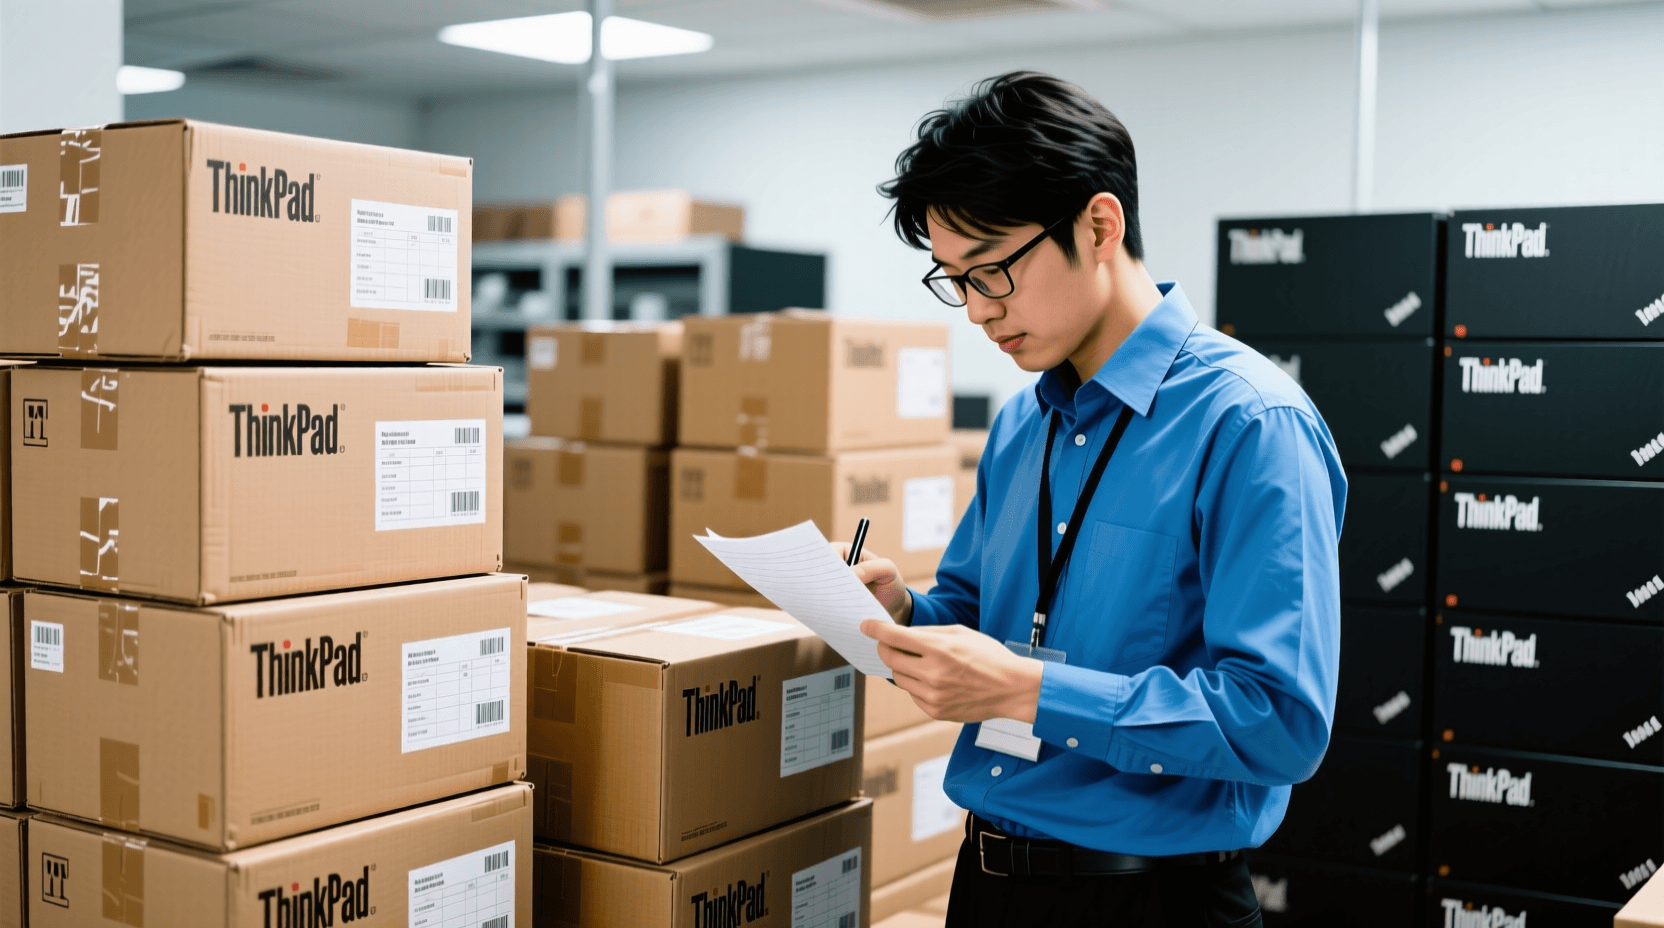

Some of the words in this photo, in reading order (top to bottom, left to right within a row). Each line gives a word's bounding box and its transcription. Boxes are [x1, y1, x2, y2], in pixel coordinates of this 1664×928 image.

[208, 160, 315, 222] ThinkPad
[1462, 222, 1547, 258] ThinkPad
[1459, 357, 1543, 394] ThinkPad
[230, 404, 337, 457] ThinkPad
[1454, 492, 1542, 531] ThinkPad
[251, 630, 362, 698] ThinkPad
[1450, 627, 1538, 668] ThinkPad
[683, 676, 757, 737] ThinkPad
[1447, 763, 1531, 806] ThinkPad
[258, 866, 369, 928] ThinkPad
[691, 873, 766, 928] ThinkPad
